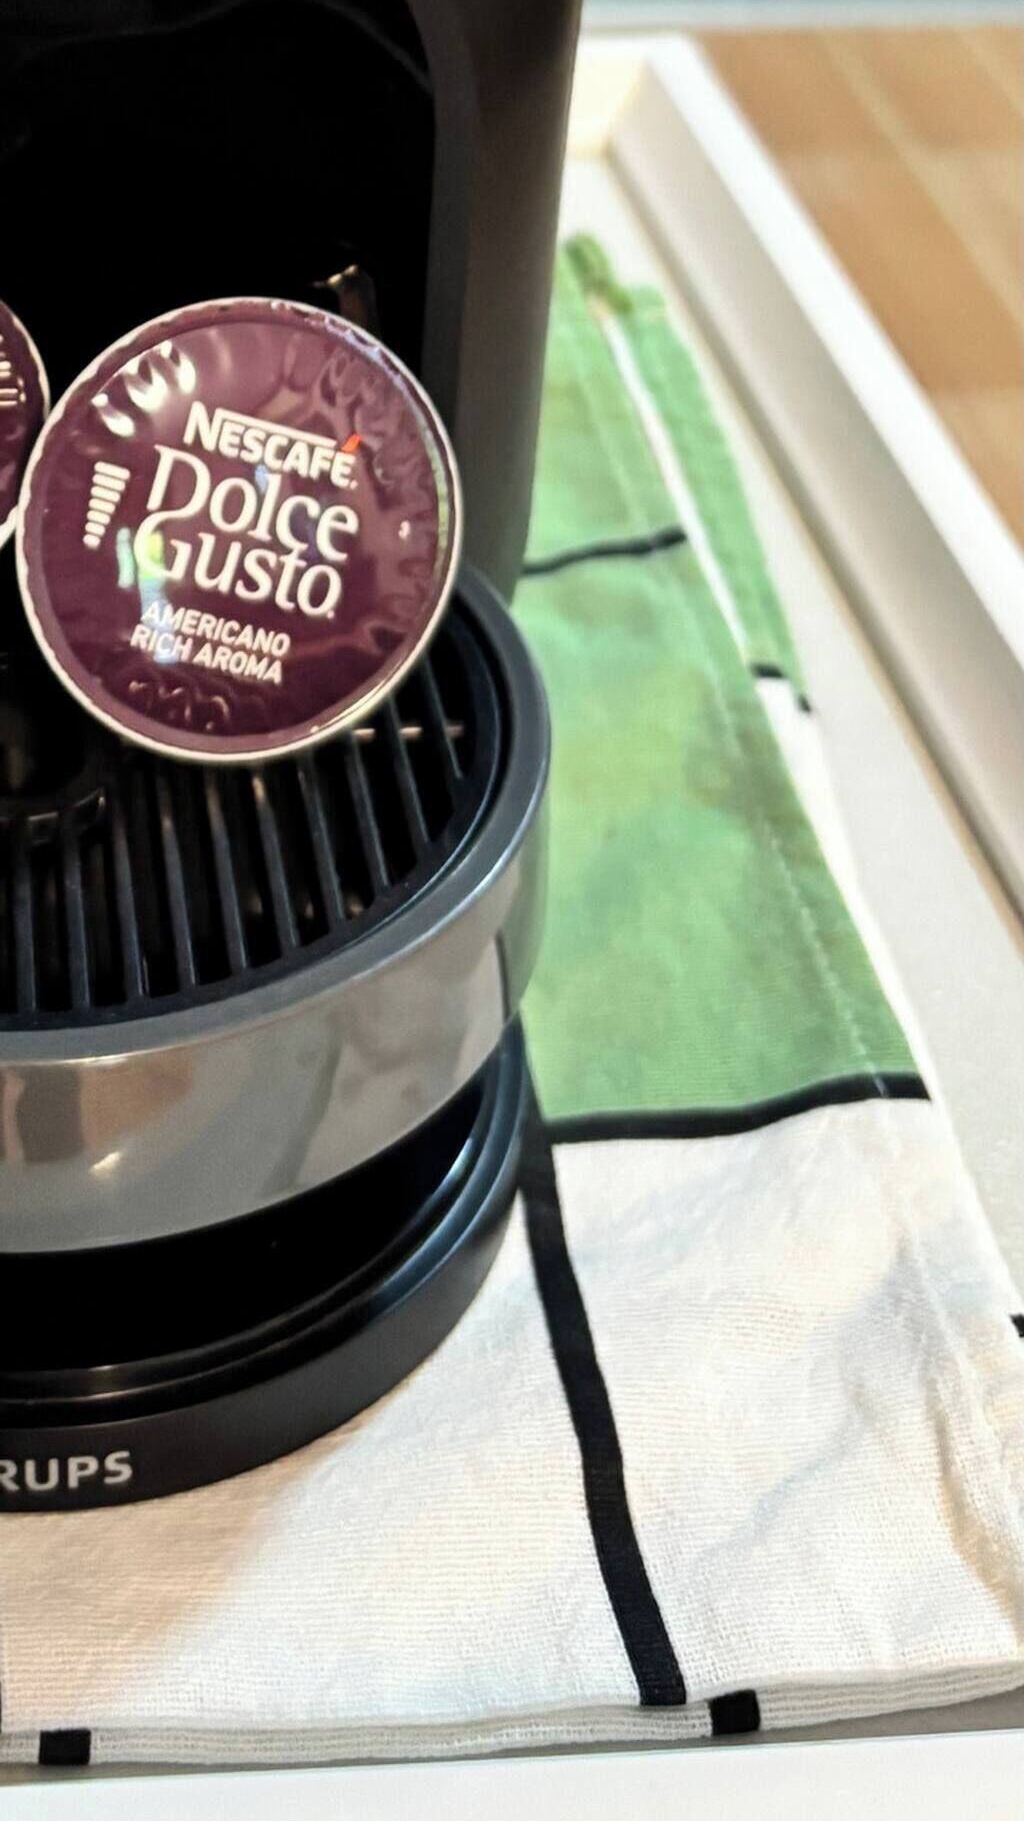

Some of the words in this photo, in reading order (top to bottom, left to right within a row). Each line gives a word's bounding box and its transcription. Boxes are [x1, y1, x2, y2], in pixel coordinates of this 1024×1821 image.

[183, 401, 362, 489] NESCAFÉ
[145, 443, 359, 562] Dolce
[133, 508, 343, 619] Gusto
[129, 623, 194, 663] RICH
[192, 648, 284, 685] AROMA
[141, 600, 291, 655] AMERICANO
